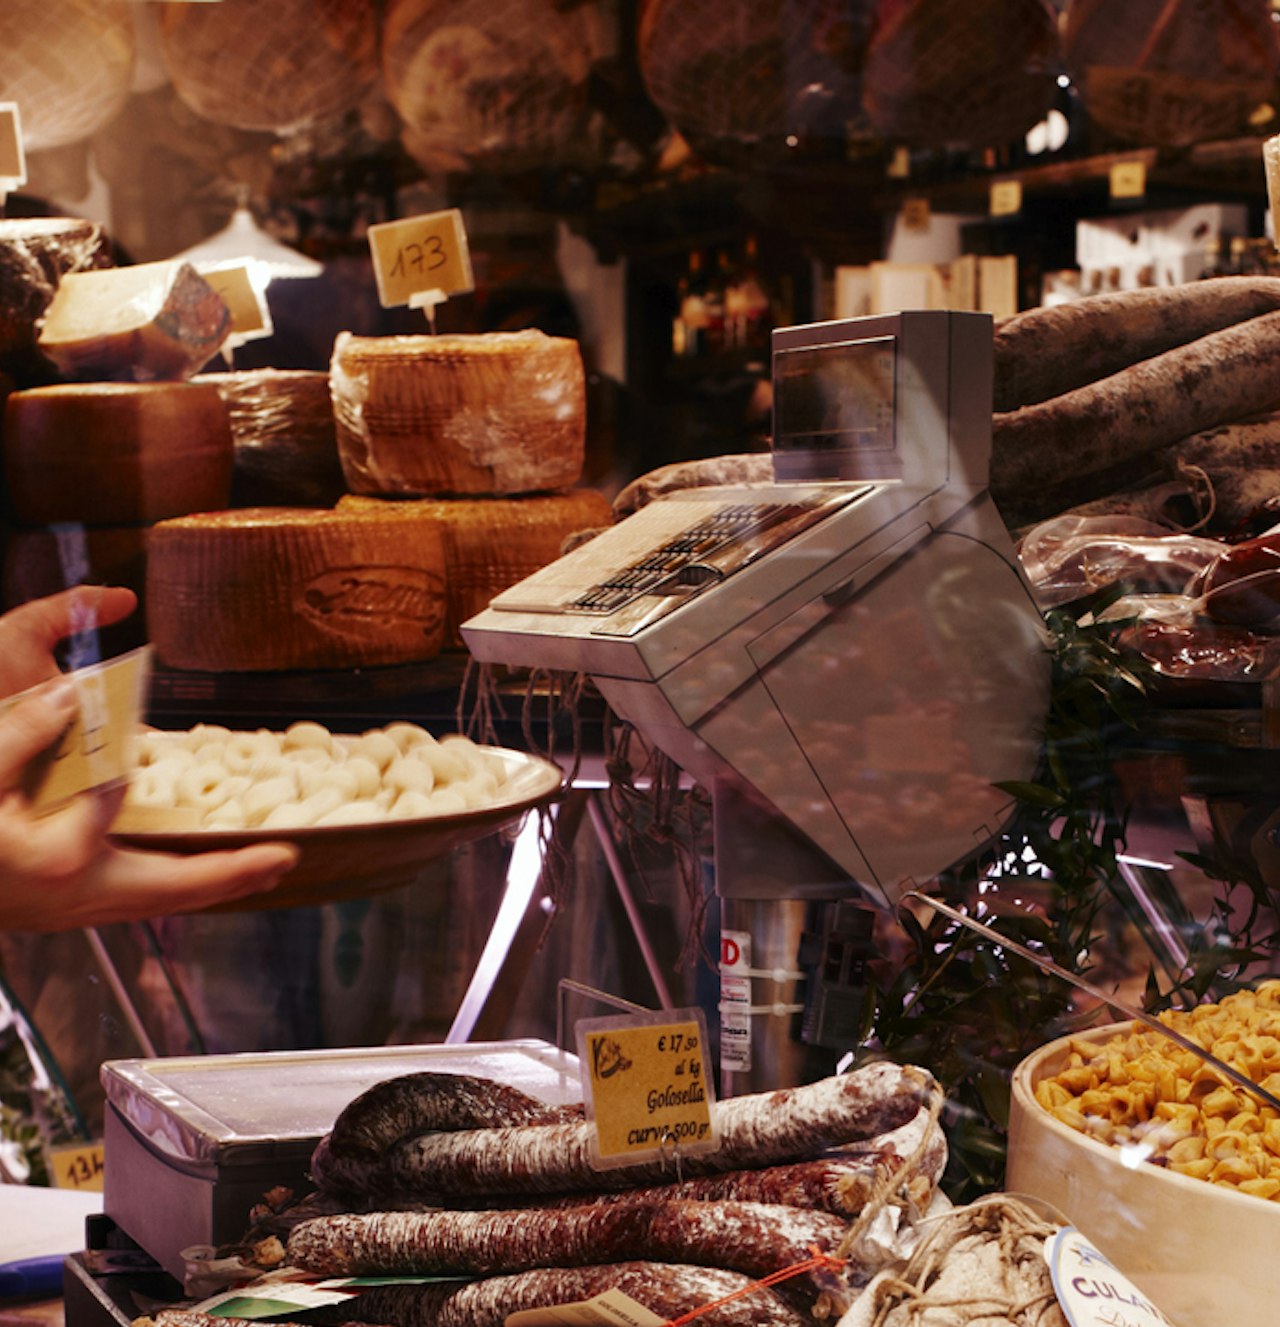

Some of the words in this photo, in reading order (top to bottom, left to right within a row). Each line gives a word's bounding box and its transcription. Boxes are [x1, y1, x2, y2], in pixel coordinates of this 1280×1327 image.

[390, 235, 448, 278] 173
[689, 1057, 701, 1079] kg
[647, 1081, 705, 1114] Golosella
